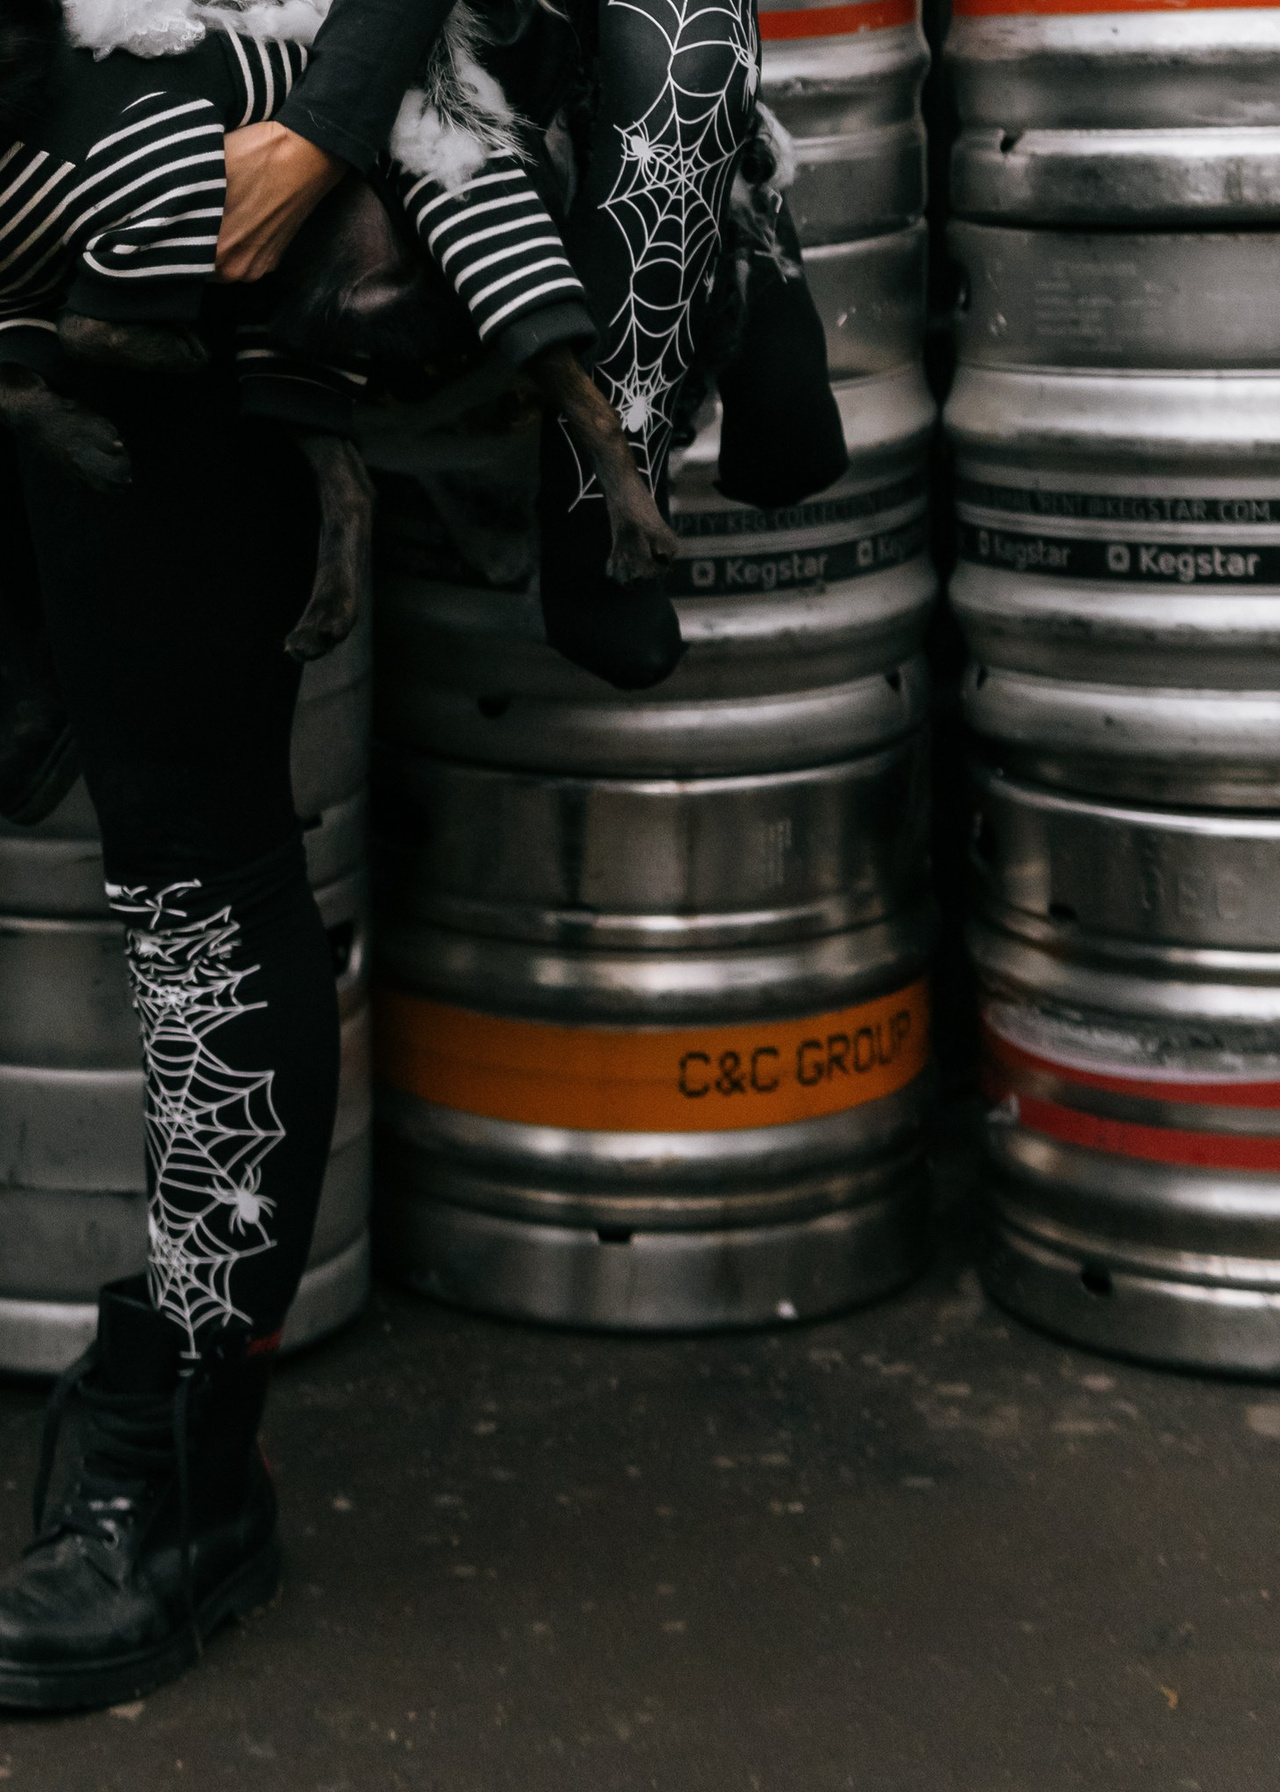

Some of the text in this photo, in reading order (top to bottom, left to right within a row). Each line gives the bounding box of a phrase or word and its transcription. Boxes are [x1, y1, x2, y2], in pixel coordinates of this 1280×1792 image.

[725, 552, 829, 589] Kegstar
[994, 533, 1072, 571] Kegstar
[1139, 545, 1261, 582] Kegstar
[677, 1010, 911, 1100] C&C GROUP
